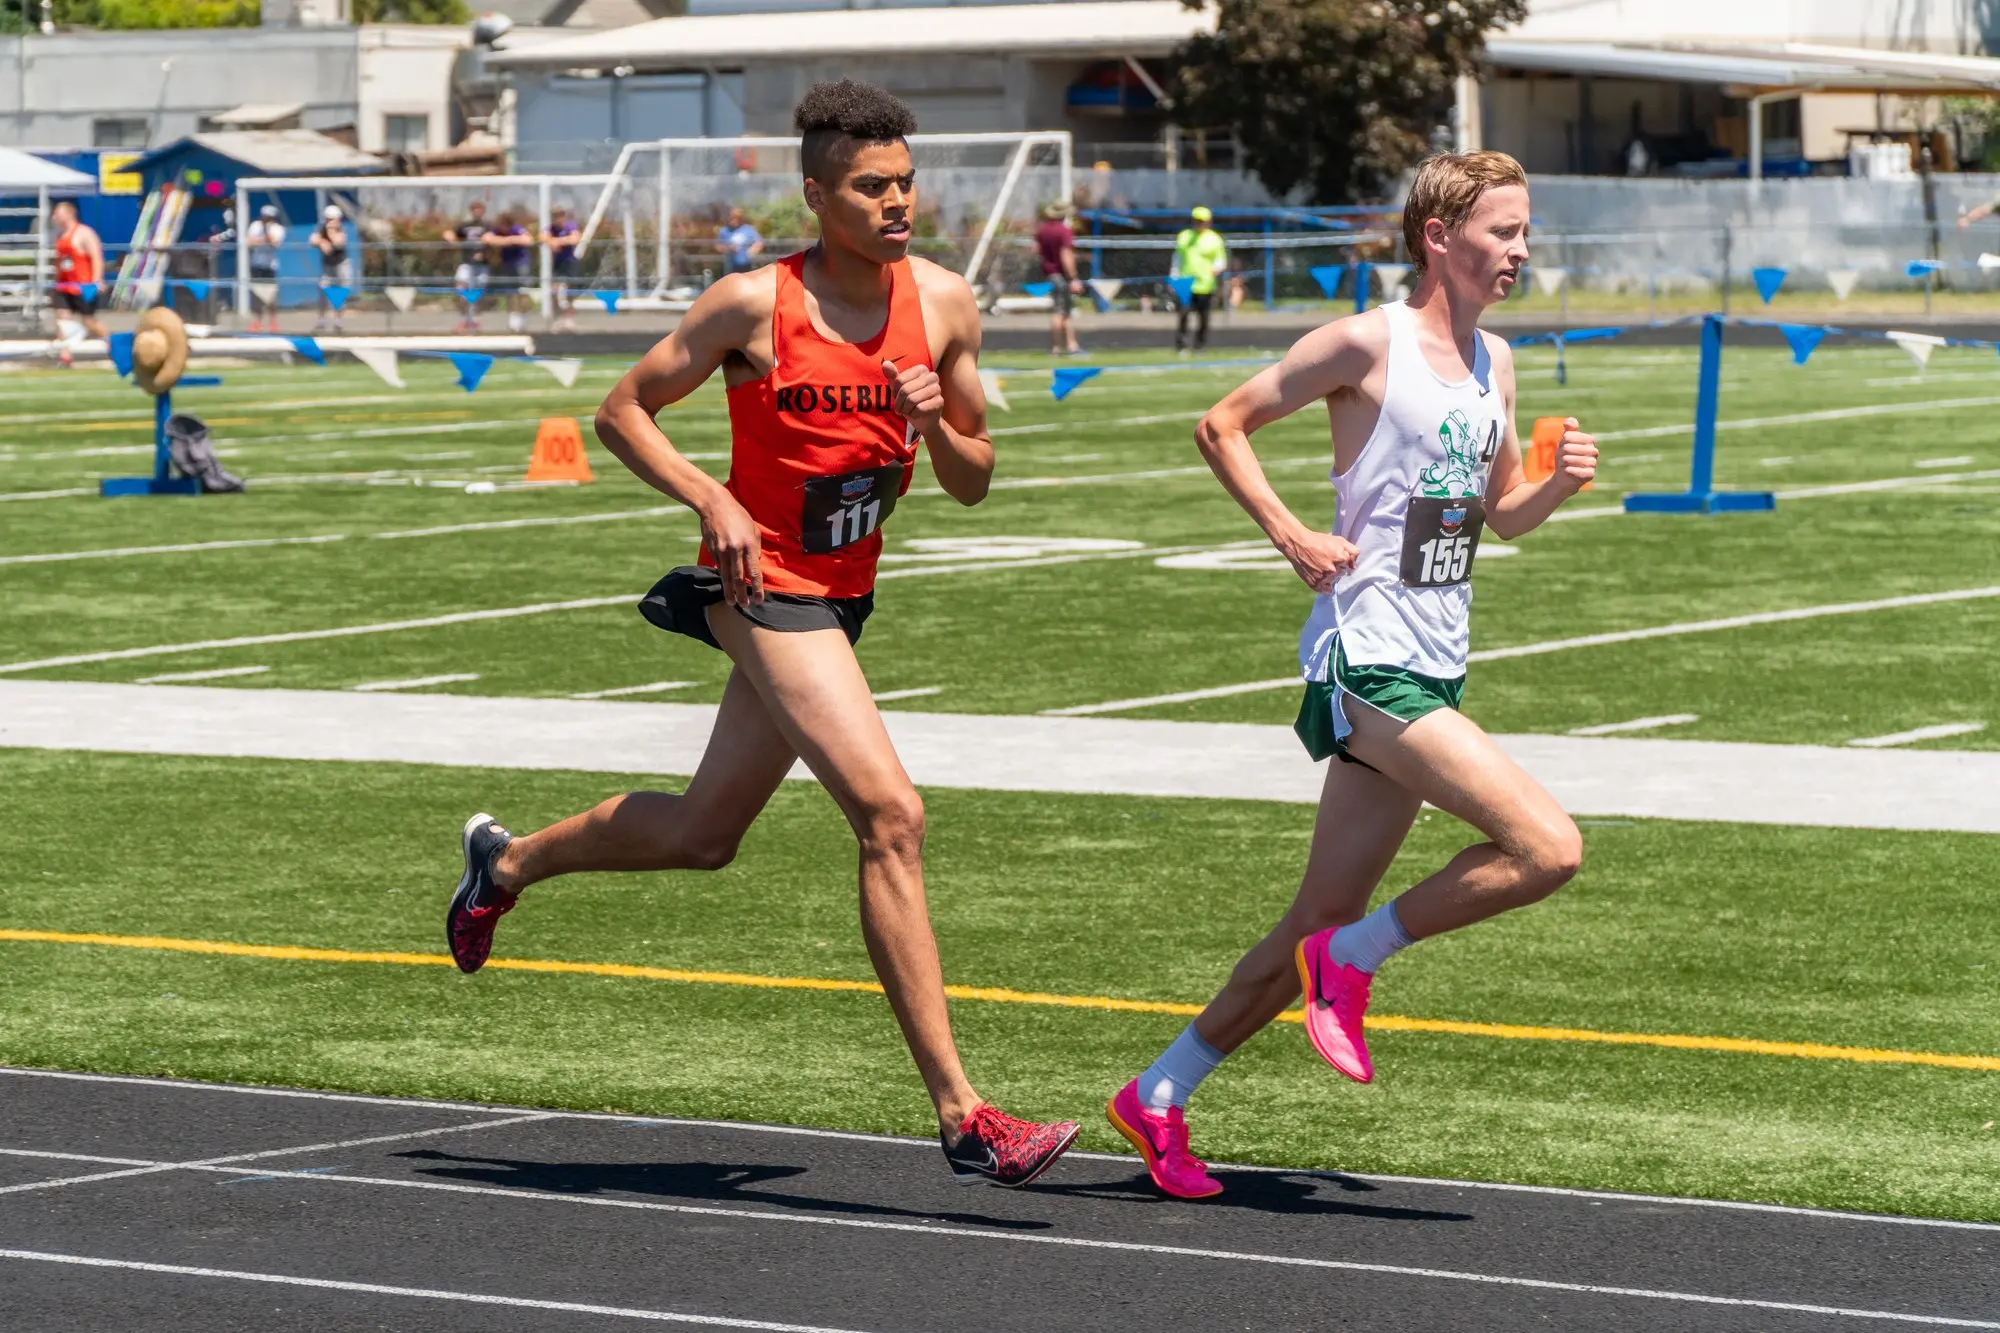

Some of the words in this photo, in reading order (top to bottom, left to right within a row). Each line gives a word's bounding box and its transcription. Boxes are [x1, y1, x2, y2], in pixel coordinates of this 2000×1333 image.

[776, 385, 892, 413] ROSEBU
[542, 435, 577, 465] 100
[1535, 440, 1558, 473] 12
[826, 499, 880, 547] 111
[1420, 536, 1471, 583] 155
